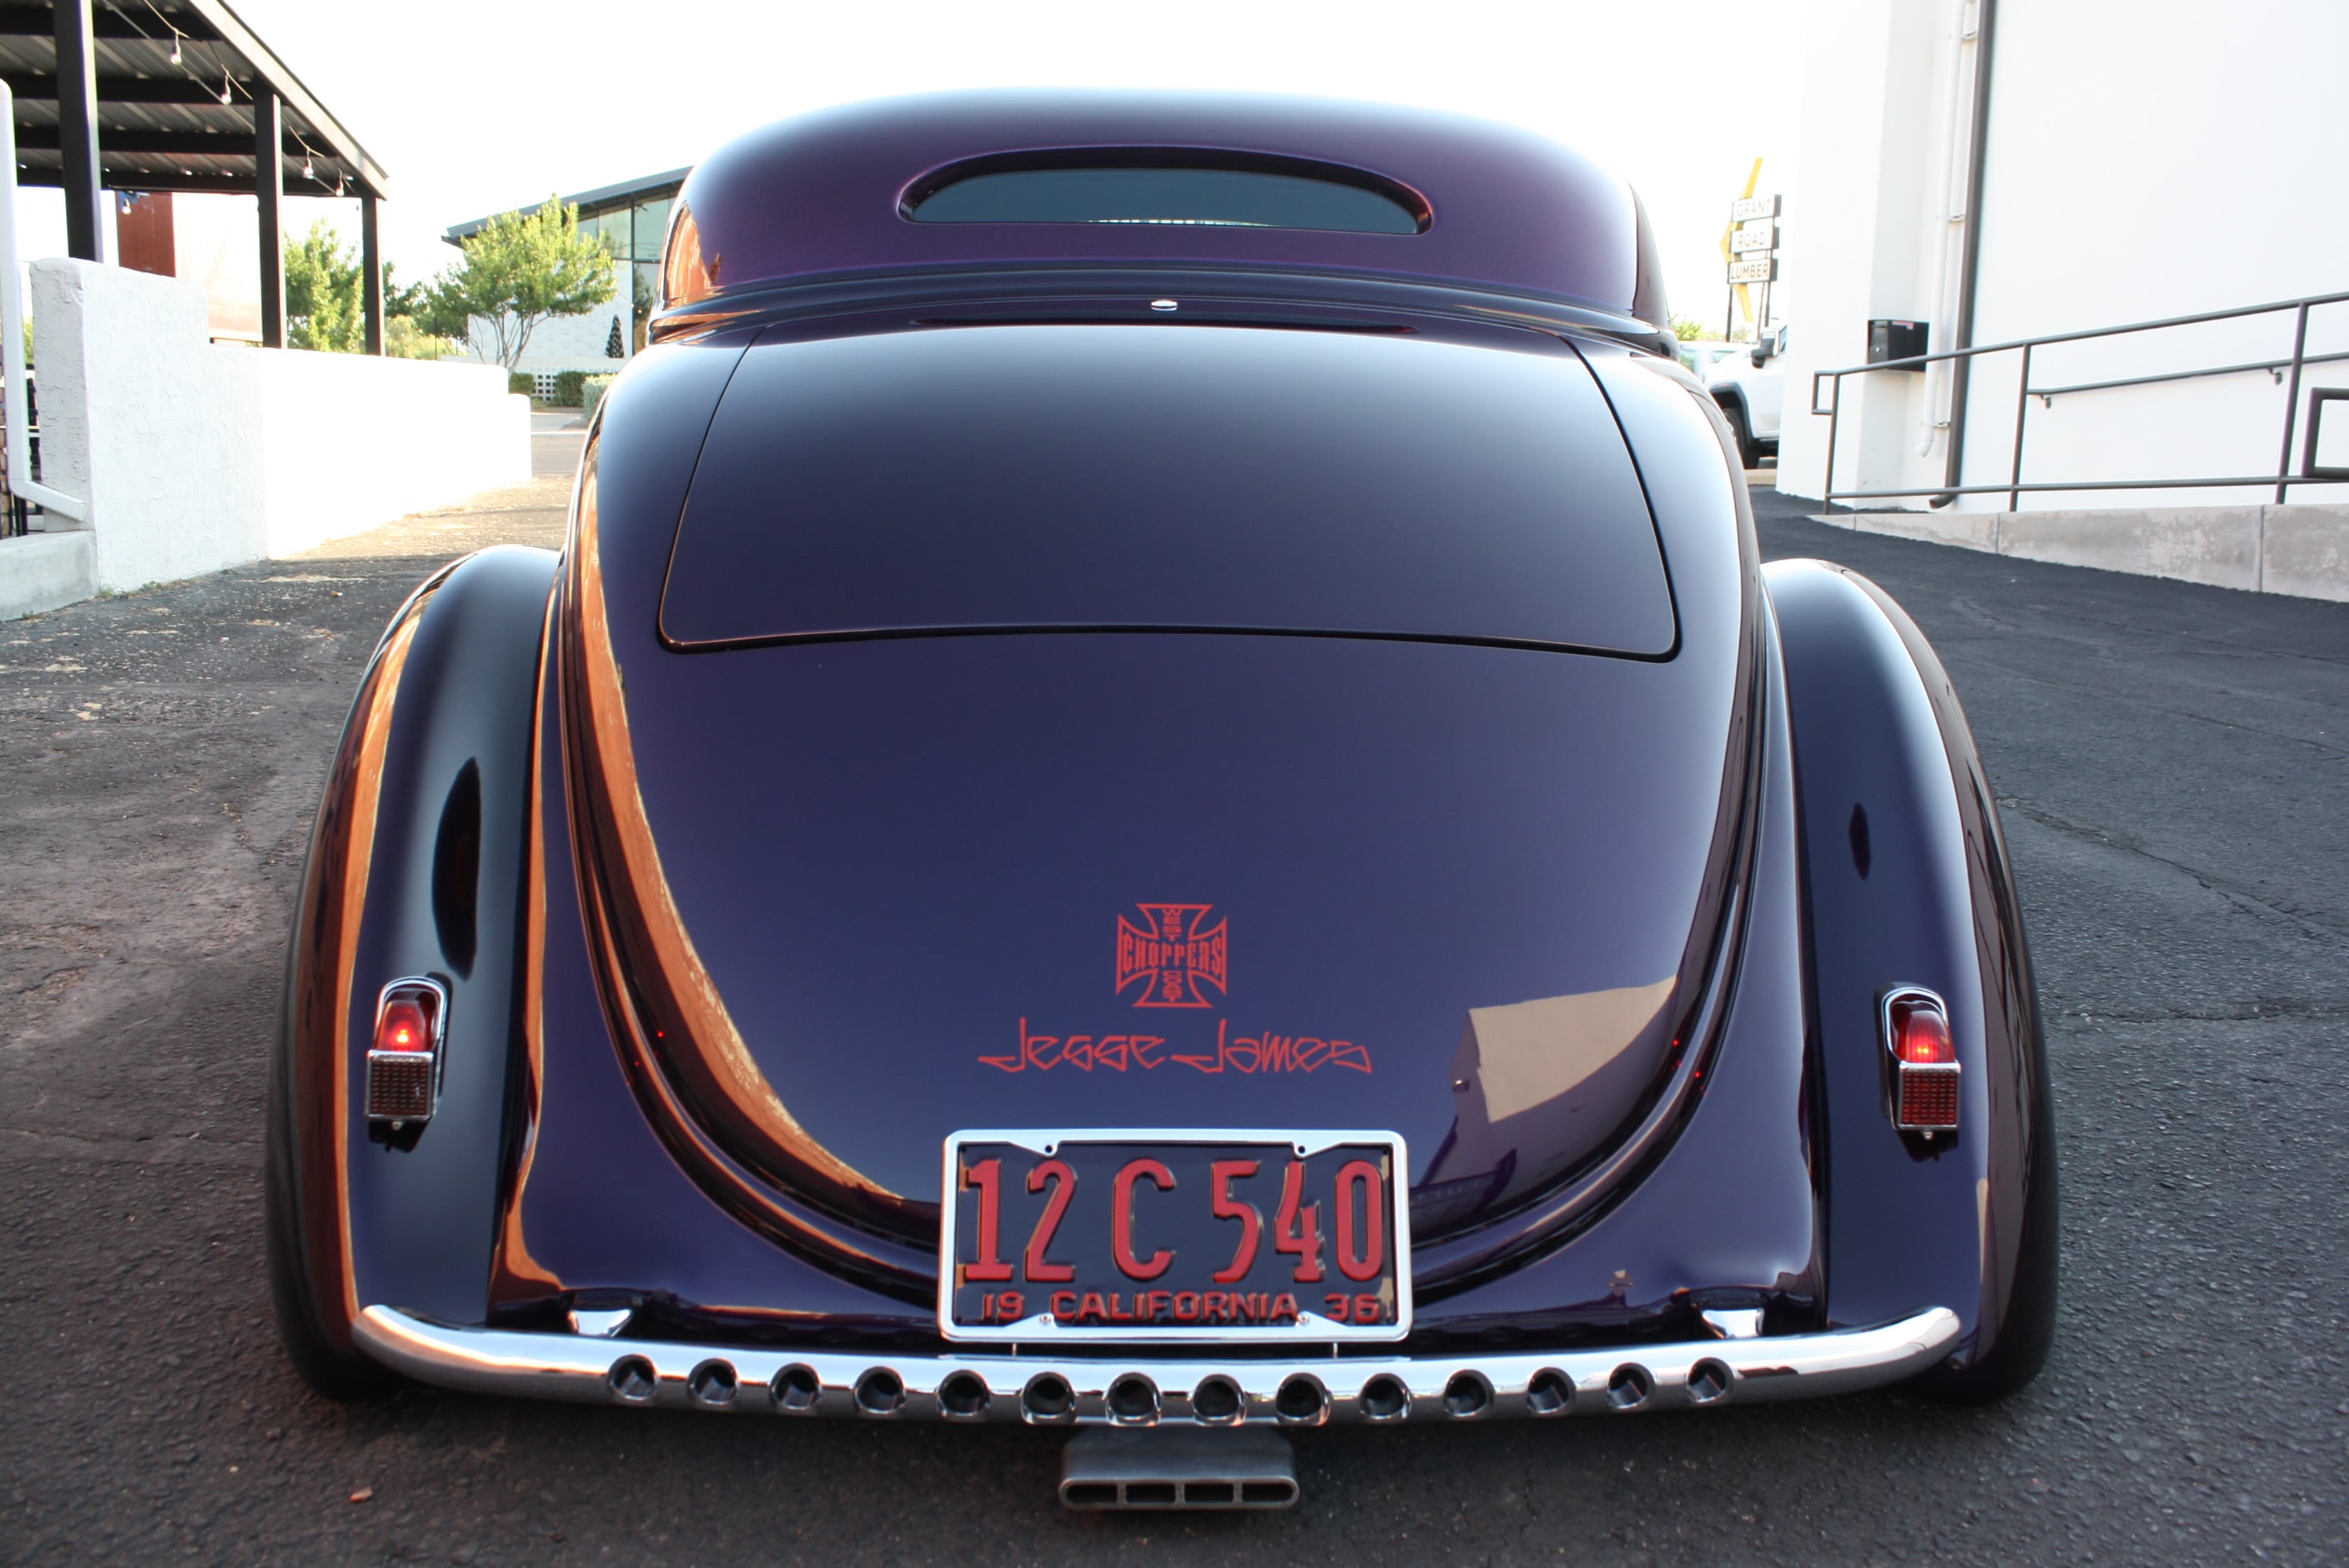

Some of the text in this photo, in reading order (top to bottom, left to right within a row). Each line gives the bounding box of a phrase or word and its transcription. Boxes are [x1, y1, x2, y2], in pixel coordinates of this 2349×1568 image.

[1737, 199, 1770, 217] GRANT
[1738, 232, 1765, 249] ROAD
[1731, 264, 1768, 279] LUMBER
[1123, 931, 1222, 975] CHOPPERS
[978, 1017, 1372, 1074] Jesse James
[963, 1157, 1385, 1284] 12 C 540
[982, 1290, 1381, 1323] 19 CALIFORNIA 36
